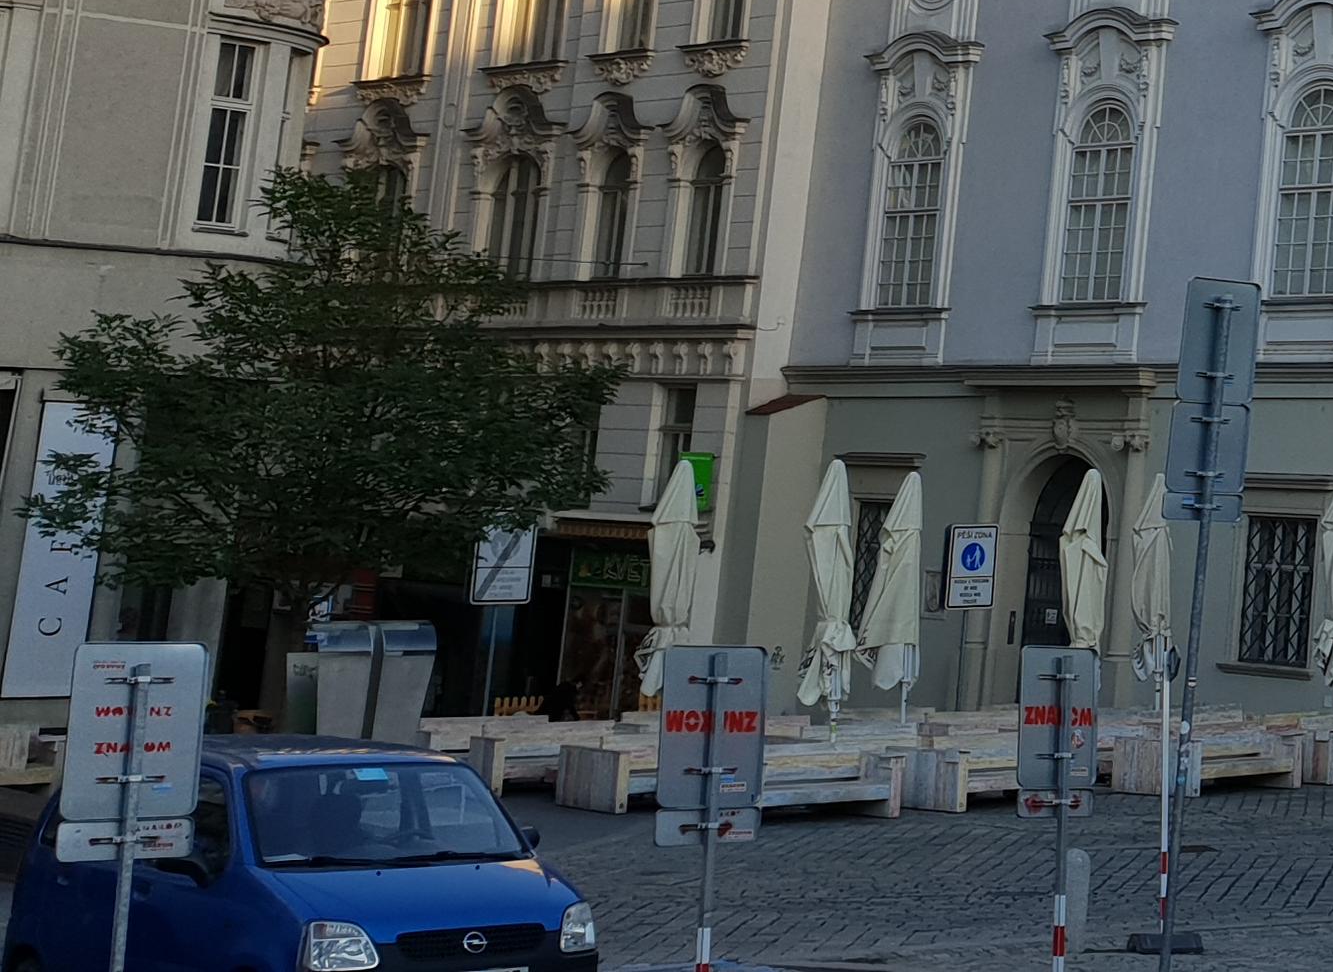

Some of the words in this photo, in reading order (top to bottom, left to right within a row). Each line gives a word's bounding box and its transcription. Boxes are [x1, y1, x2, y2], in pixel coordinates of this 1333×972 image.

[666, 710, 759, 733] ZNKOM
[1023, 705, 1093, 727] ZNAOM
[94, 741, 172, 755] ZNAOM
